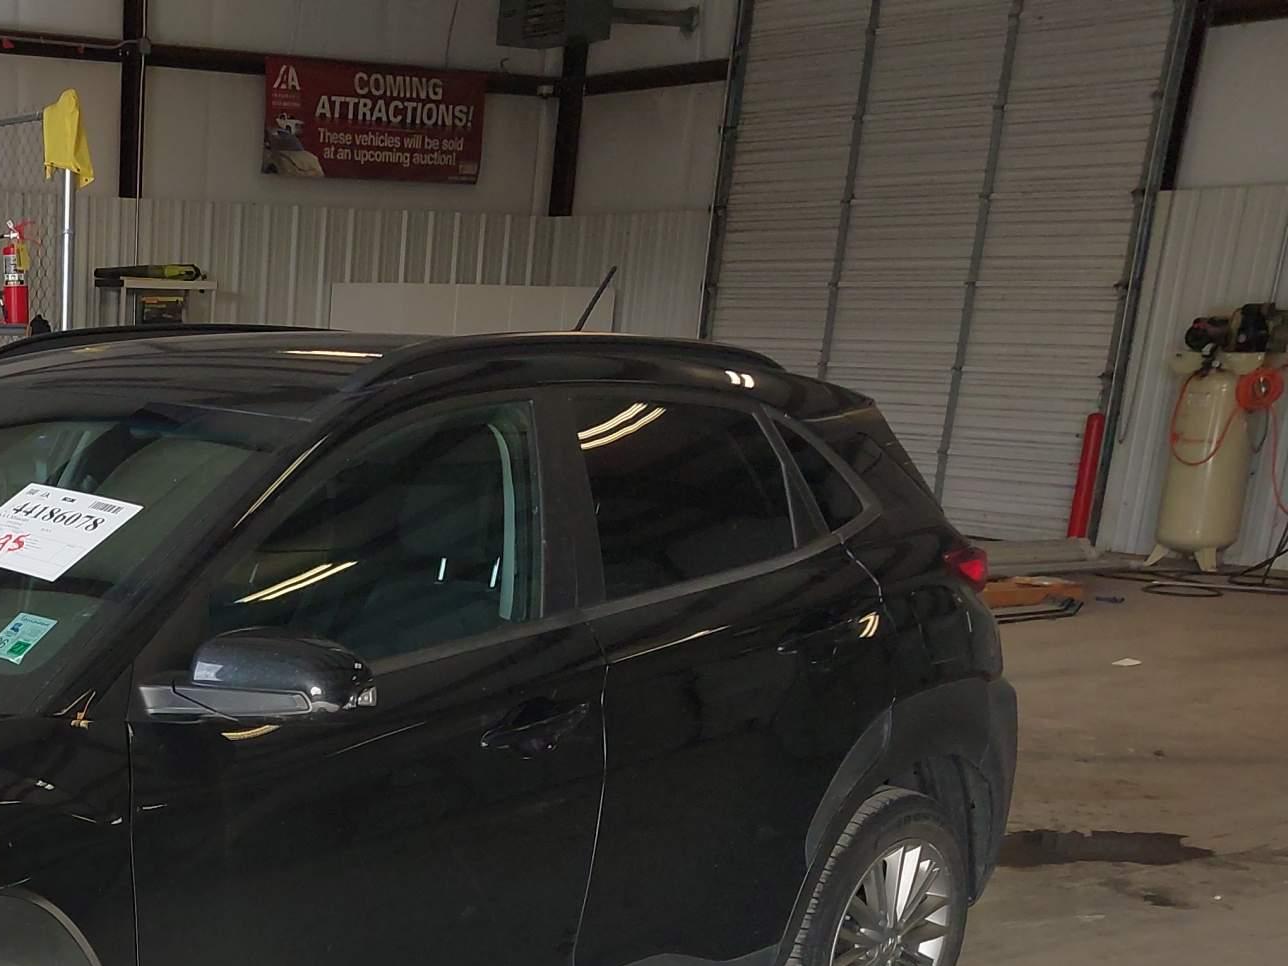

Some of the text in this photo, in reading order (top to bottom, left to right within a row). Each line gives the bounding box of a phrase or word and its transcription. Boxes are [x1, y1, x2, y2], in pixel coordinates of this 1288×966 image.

[353, 71, 443, 100] COMING
[314, 95, 475, 128] ATTRACTIONS!
[317, 127, 464, 151] These vehicles will be sold
[323, 146, 457, 168] at an upcoming auction!
[12, 501, 105, 532] 44186078
